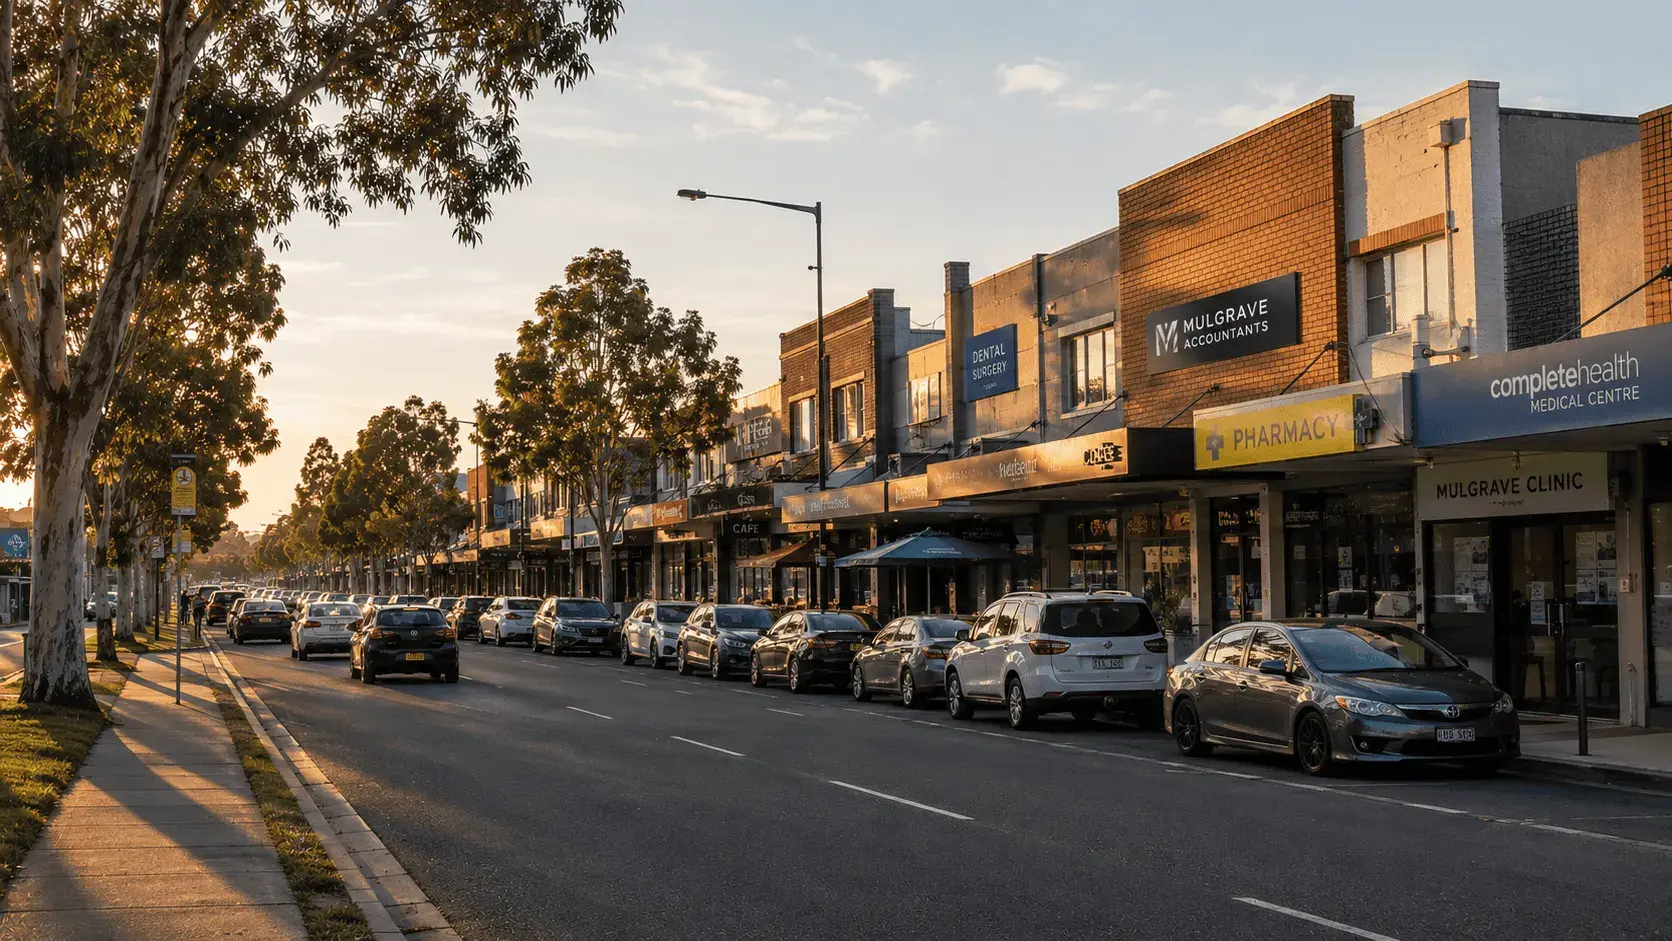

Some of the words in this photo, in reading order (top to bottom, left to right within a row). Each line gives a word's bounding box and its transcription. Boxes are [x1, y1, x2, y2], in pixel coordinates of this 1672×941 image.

[1183, 299, 1268, 333] MULGRAVE
[1183, 320, 1268, 350] ACCOUNTANTS
[972, 343, 1006, 364] DENTAL
[972, 360, 1007, 380] SURGERY
[1490, 351, 1639, 399] completehealth
[1530, 394, 1584, 413] MEDICAL
[1588, 385, 1640, 406] CENTRE
[1233, 414, 1339, 451] PHARMACY
[1436, 477, 1520, 500] MULGRAVE
[1526, 472, 1583, 493] CLINIC
[732, 523, 759, 534] CAFE
